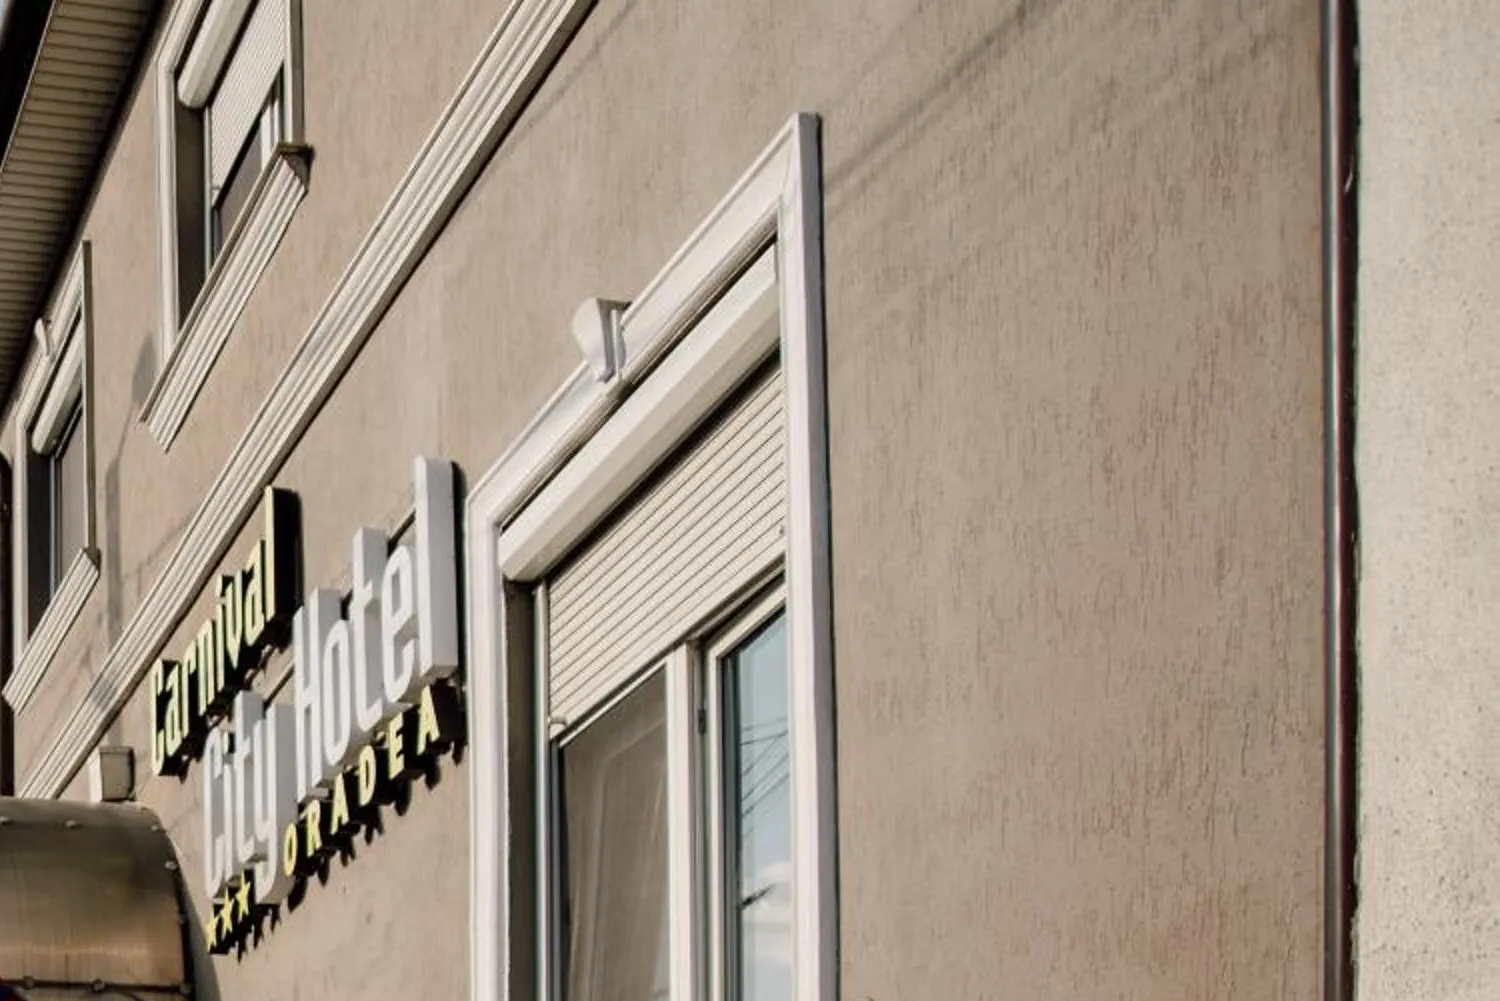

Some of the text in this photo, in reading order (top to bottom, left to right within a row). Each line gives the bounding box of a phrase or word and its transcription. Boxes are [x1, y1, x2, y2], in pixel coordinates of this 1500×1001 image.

[150, 484, 276, 776] Carnival
[203, 455, 446, 903] City Hotel
[283, 685, 442, 878] ORADEA
